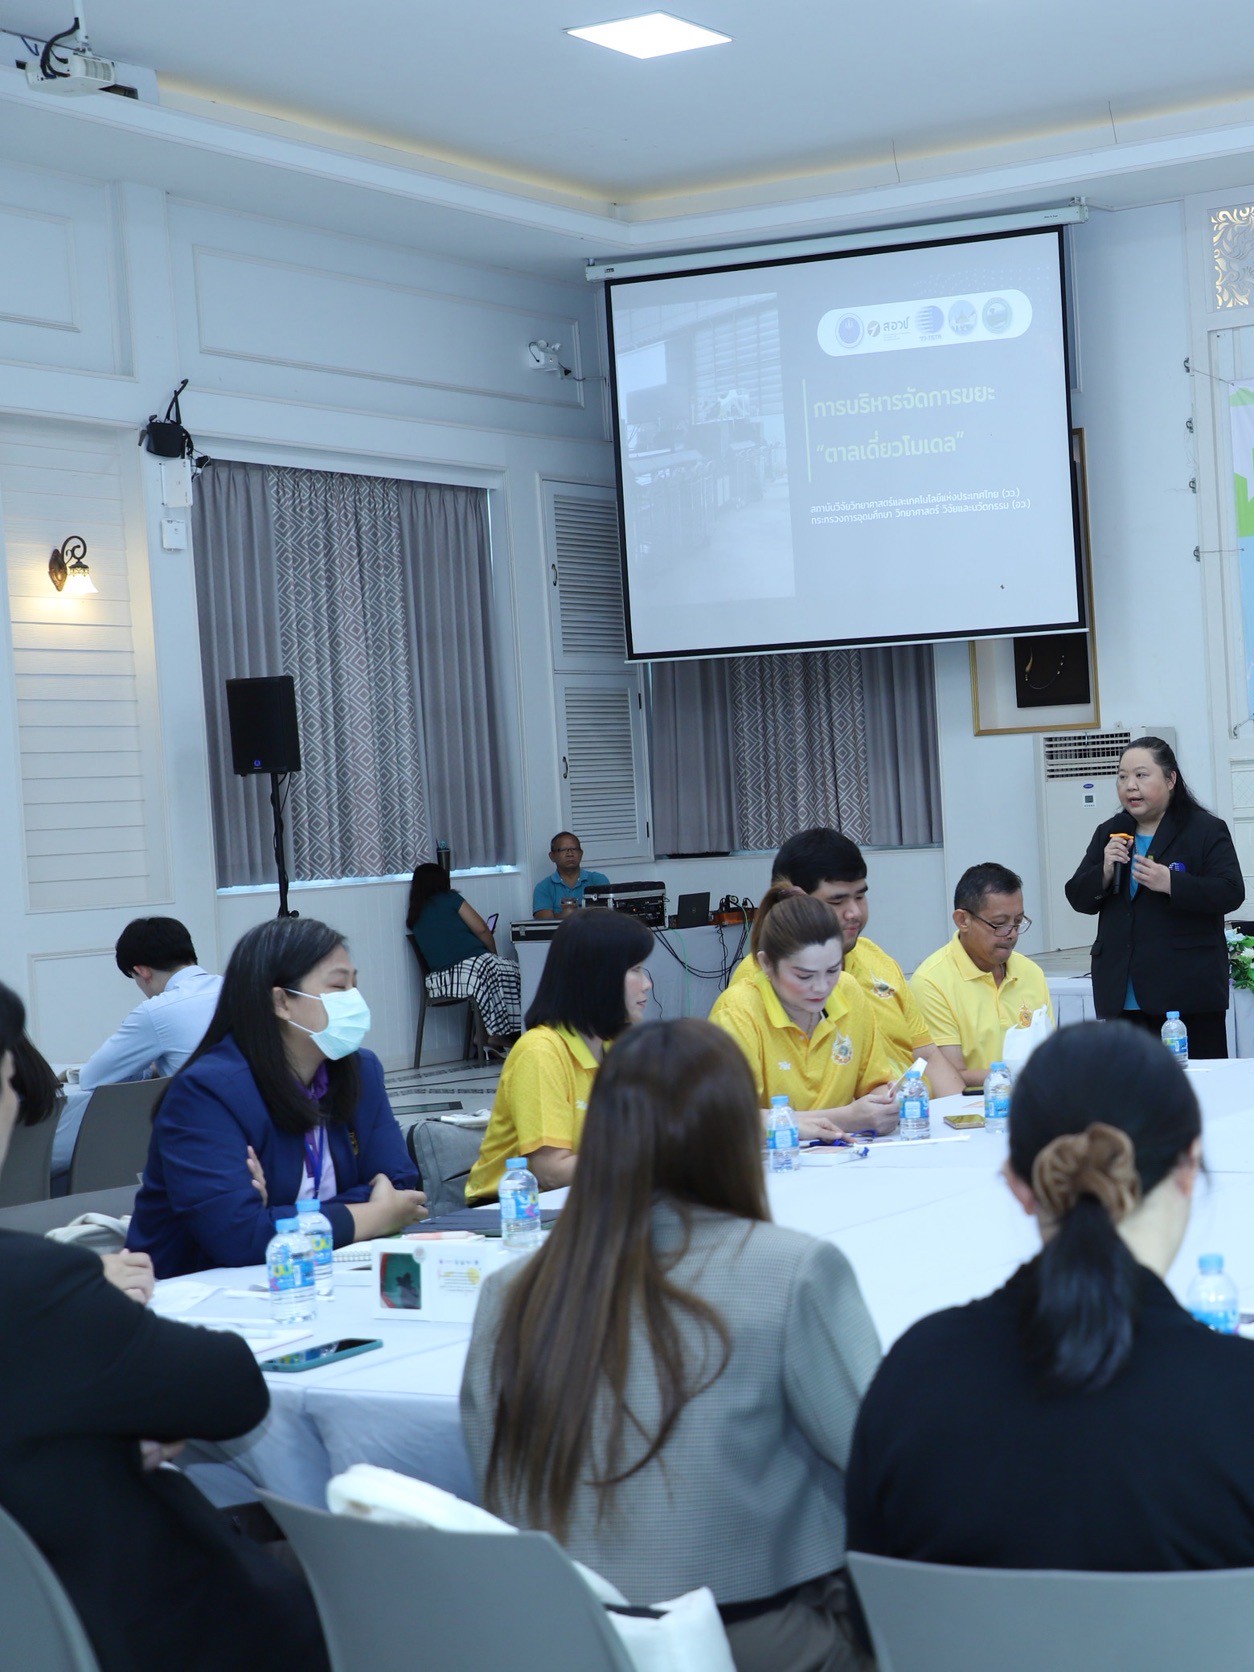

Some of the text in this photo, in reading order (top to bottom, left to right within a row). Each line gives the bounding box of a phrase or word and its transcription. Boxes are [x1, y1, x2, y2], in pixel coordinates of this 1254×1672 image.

[813, 386, 996, 418] การบริหารจัดการขยะ
